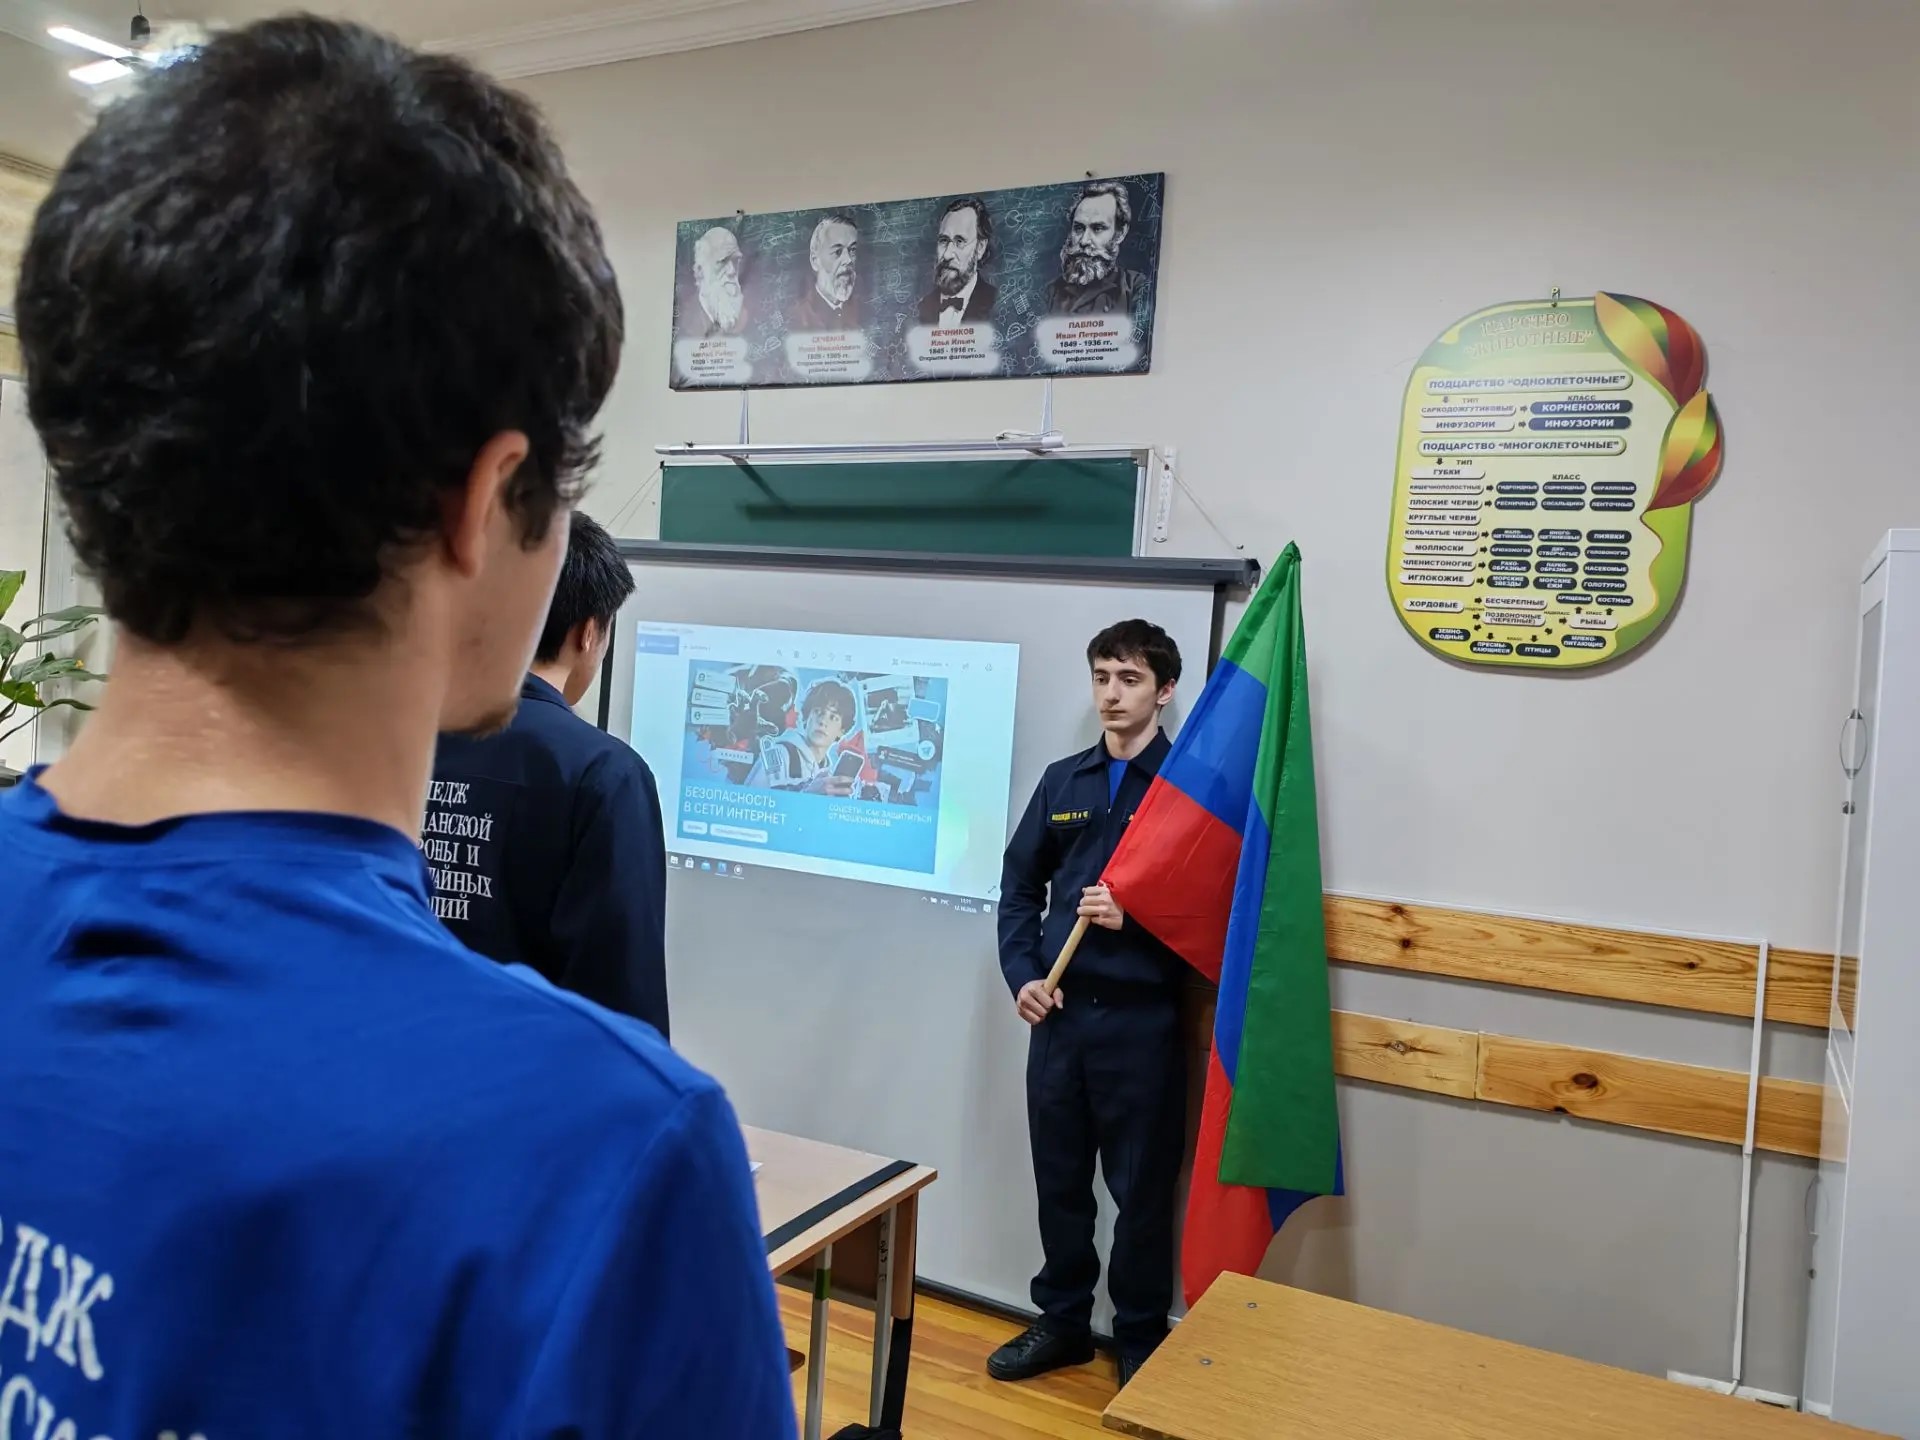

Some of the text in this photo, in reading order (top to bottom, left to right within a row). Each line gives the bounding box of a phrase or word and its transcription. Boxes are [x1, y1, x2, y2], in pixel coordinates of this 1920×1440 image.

[1069, 320, 1104, 328] ПАВЛОВ
[931, 328, 974, 337] МЕЧНИКОВ
[1079, 331, 1118, 339] Петрович
[1429, 379, 1505, 389] ПОДЦАРСТВО
[1542, 403, 1620, 412] КОРНЕНОЖКИ
[1545, 419, 1614, 428] ИНФУЗОРИИ
[1423, 443, 1495, 451] ПОДЦАРСТВО
[1410, 600, 1459, 608] ХОРДОВЫЕ
[1485, 598, 1545, 606] БЕСЧЕРЕПНЫЕ
[685, 785, 776, 808] БЕЗОПАСНОСТЬ
[684, 801, 787, 824] В СЕТИ ИНТЕРНЕТ
[865, 808, 879, 817] КАК
[466, 843, 480, 867] И
[0, 1222, 113, 1380] ДЖ
